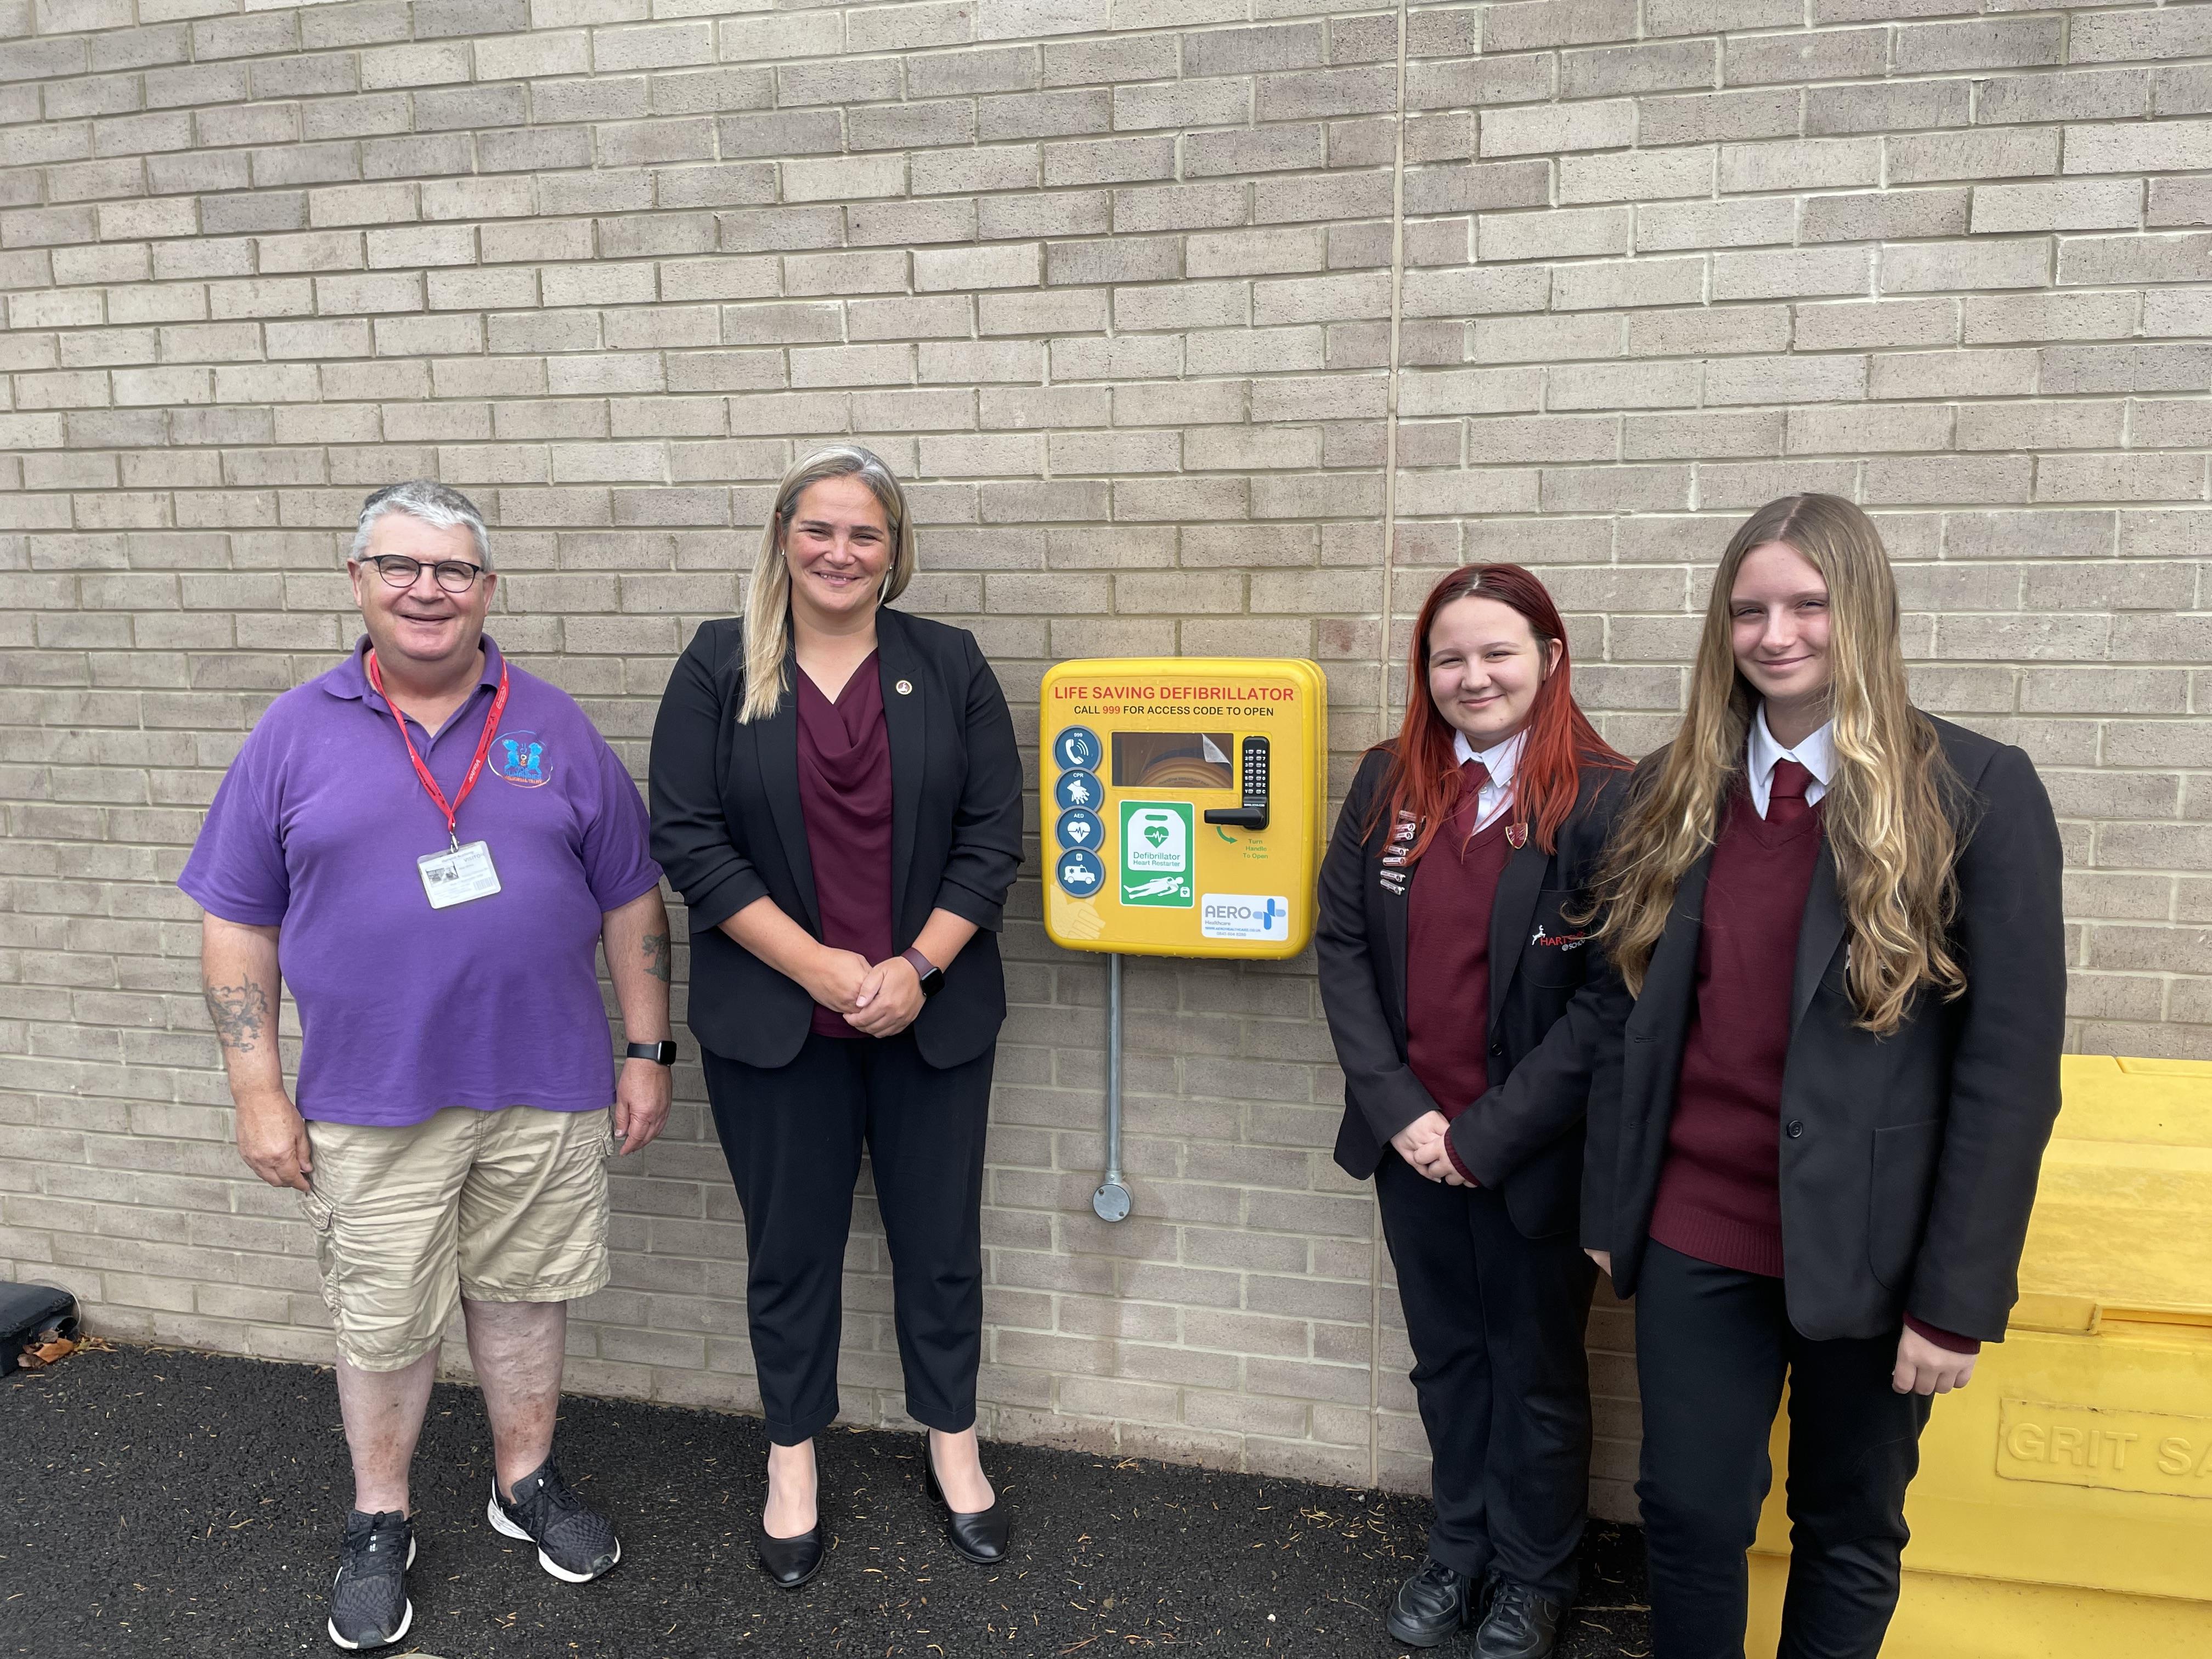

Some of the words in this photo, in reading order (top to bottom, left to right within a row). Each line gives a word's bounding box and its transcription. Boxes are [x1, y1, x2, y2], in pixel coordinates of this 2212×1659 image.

[1055, 687, 1088, 699] LIFE
[1092, 687, 1155, 699] SAVING
[1160, 687, 1294, 701] DEFIBRILLATOR
[1074, 706, 1100, 714] CALL
[1103, 706, 1120, 714] 999
[1124, 706, 1144, 714] FOR
[1147, 706, 1190, 715] ACCESS
[1193, 706, 1223, 715] CODE
[1226, 707, 1241, 715] TO
[1244, 707, 1273, 716] OPEN
[469, 759, 481, 783] Visitor
[1133, 851, 1181, 860] Defibrillator
[1205, 905, 1251, 919] AERO
[2007, 1423, 2138, 1470] GRIT
